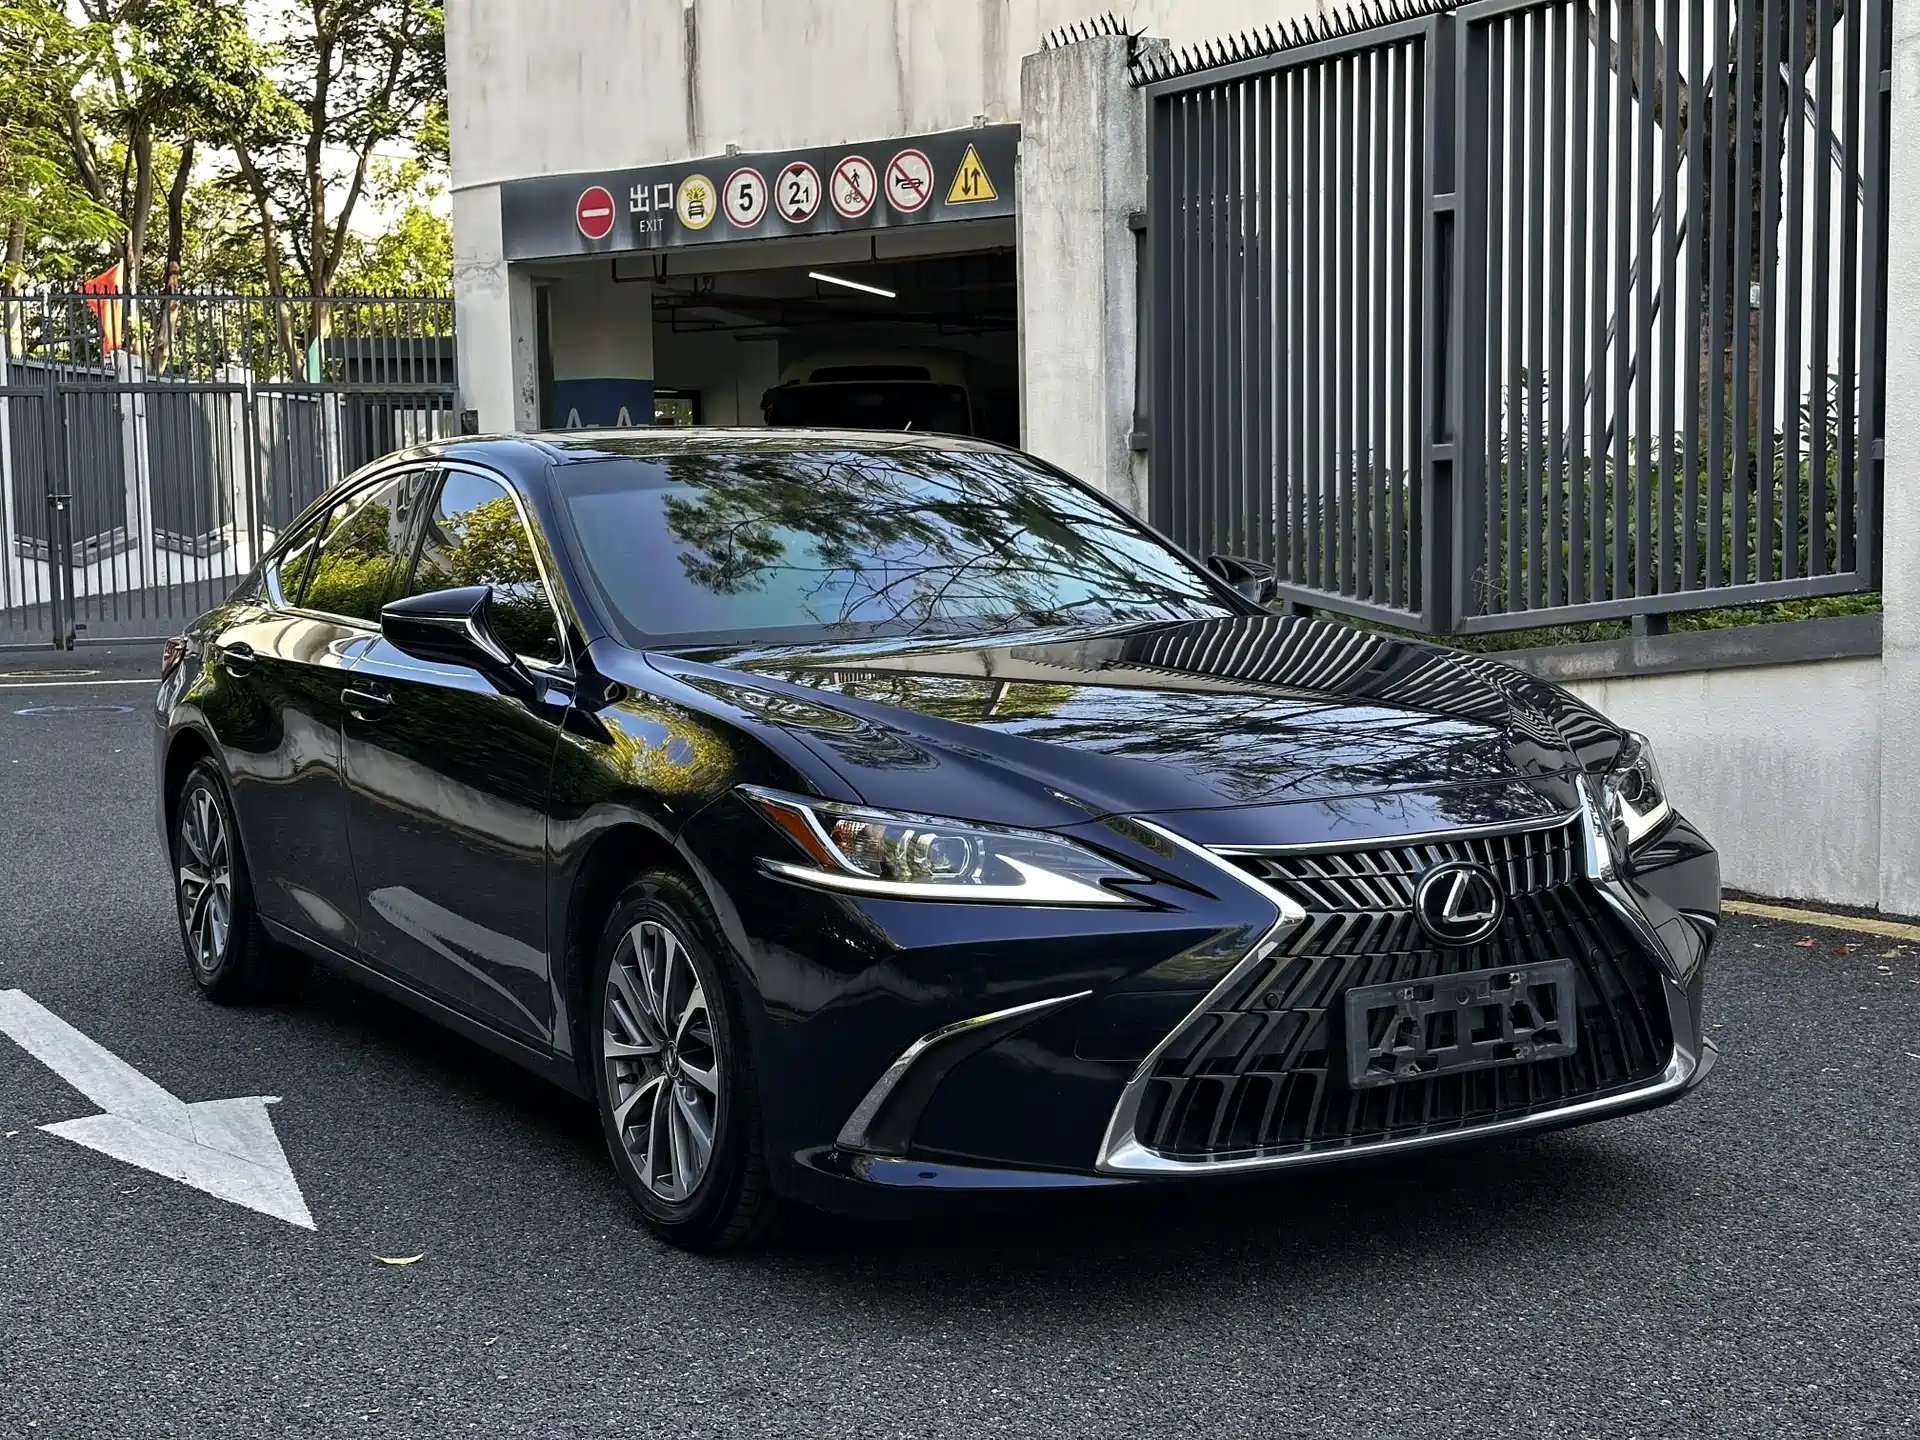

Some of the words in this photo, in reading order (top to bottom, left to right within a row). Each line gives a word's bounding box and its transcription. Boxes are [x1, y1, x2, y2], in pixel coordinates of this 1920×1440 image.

[629, 183, 674, 213] 出口
[738, 183, 754, 212] 5
[788, 181, 810, 206] 2.1
[639, 218, 664, 233] EXIT
